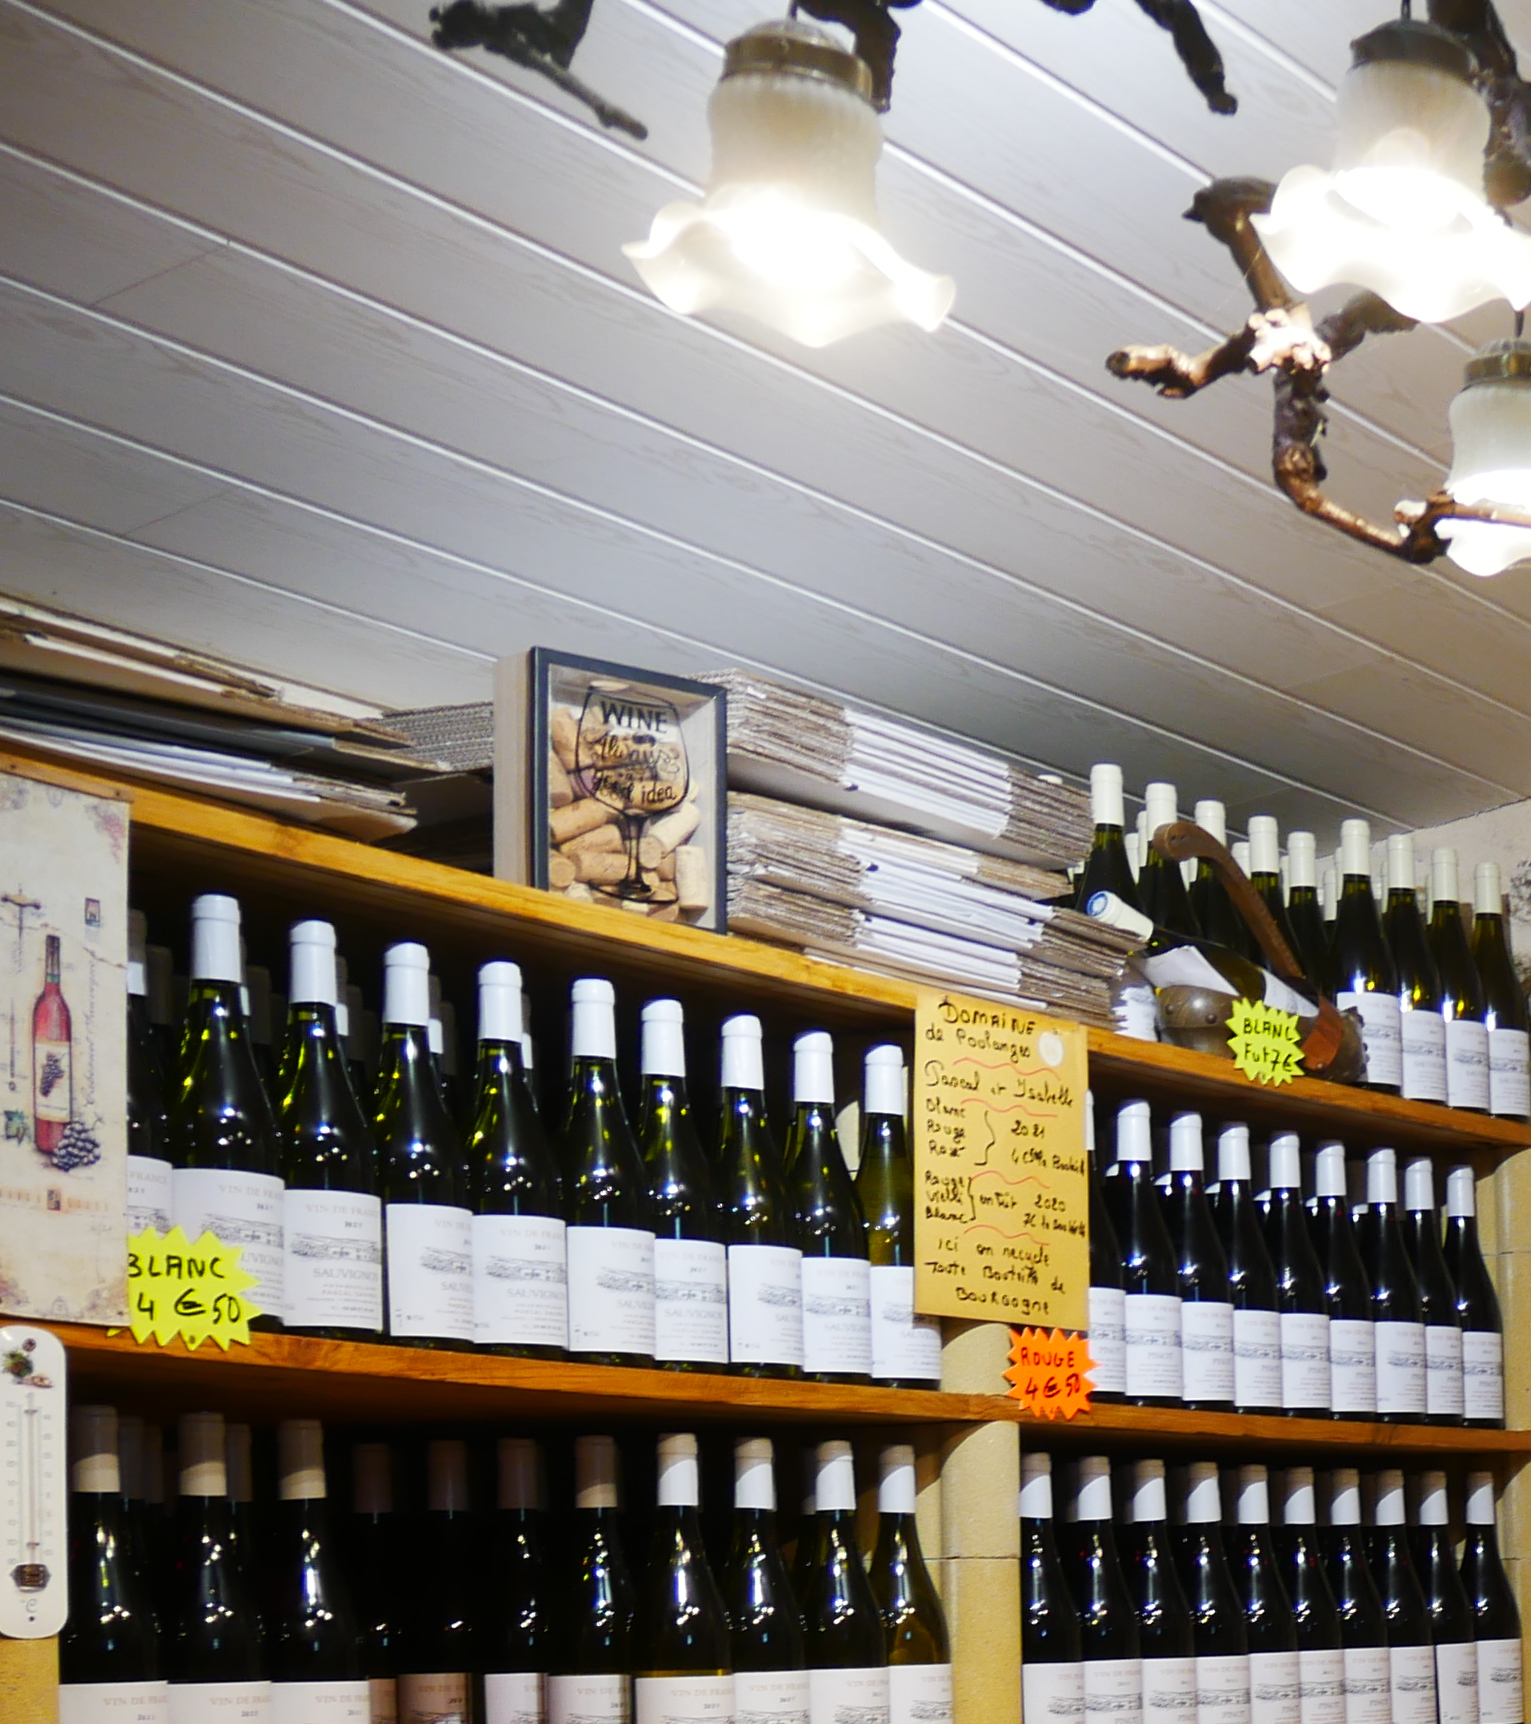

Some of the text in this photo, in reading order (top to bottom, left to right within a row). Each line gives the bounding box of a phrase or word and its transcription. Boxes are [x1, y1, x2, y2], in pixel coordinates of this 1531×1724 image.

[600, 700, 668, 734] WINE
[640, 780, 678, 804] idea
[1244, 1017, 1294, 1041] BLANC
[218, 1184, 242, 1194] VIN
[306, 1203, 329, 1213] VIN
[1020, 1346, 1076, 1369] ROUGE
[103, 1697, 126, 1706] VIN
[209, 1696, 232, 1705] VIN
